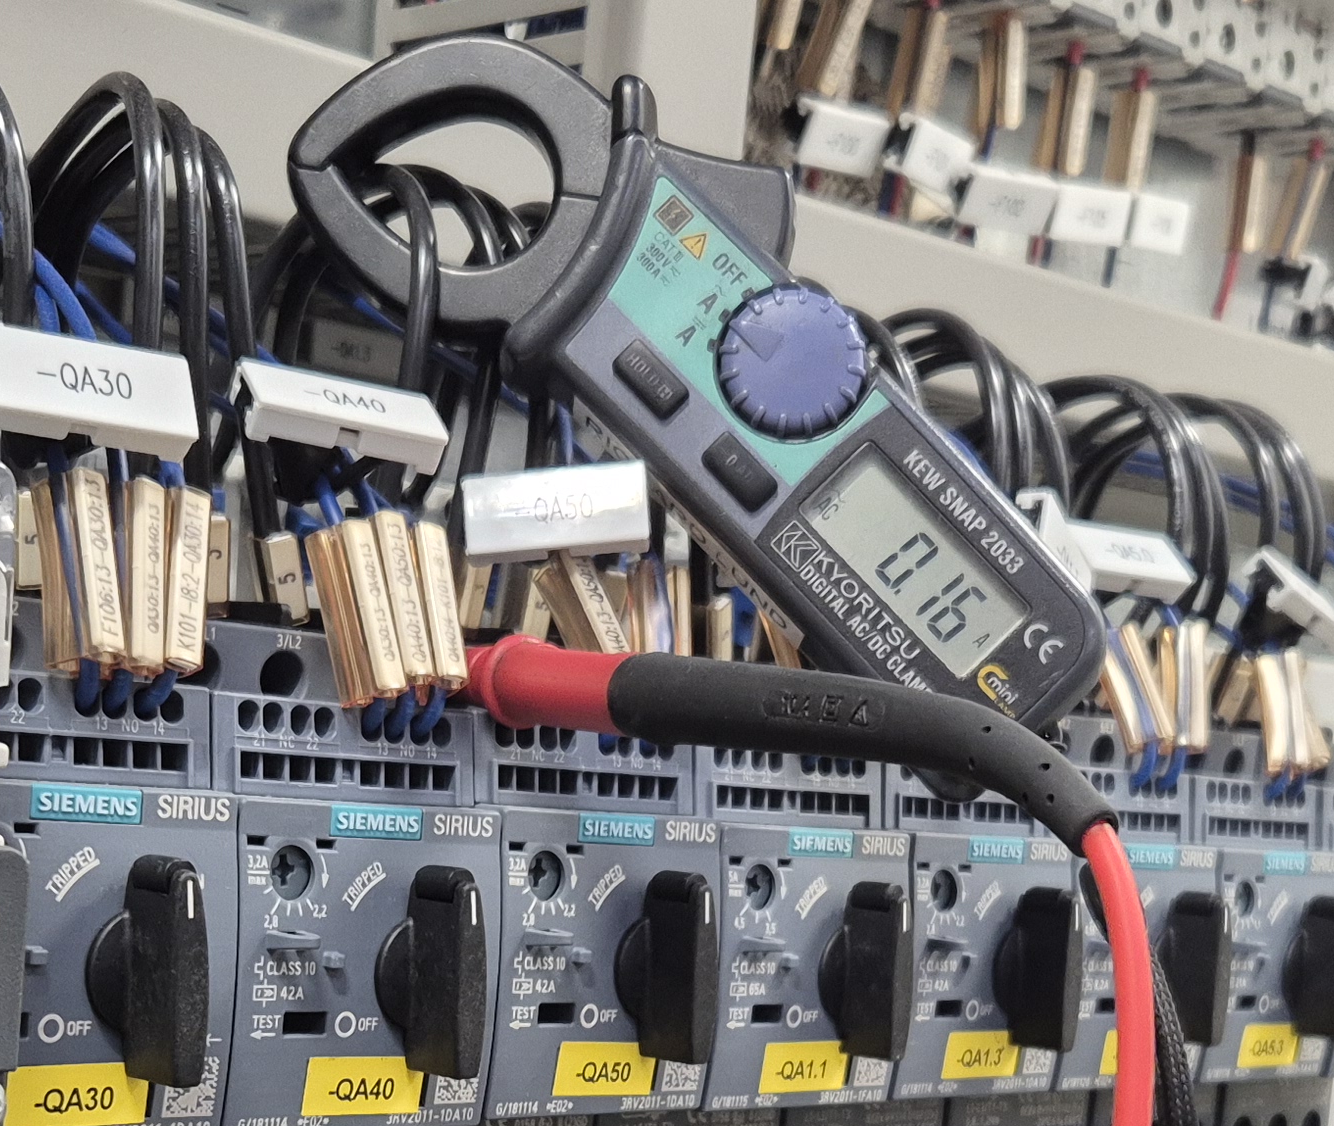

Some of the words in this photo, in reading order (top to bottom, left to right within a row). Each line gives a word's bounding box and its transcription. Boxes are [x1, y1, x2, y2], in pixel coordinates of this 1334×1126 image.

[712, 251, 749, 287] OFF
[695, 292, 719, 315] A
[674, 324, 698, 348] A
[37, 362, 134, 401] -QA30
[303, 388, 388, 415] -QA40
[815, 494, 840, 522] AC
[902, 449, 947, 492] KEW
[939, 487, 988, 533] SNAP
[980, 530, 1025, 575] 2033
[874, 531, 988, 644] 0.16
[799, 564, 852, 624] DIGITAL
[845, 613, 888, 662] AC/DC
[812, 549, 923, 662] KYORITSU
[276, 633, 304, 651] 3/L2
[972, 632, 991, 649] A
[1023, 622, 1065, 665] CE
[987, 672, 1020, 706] mini
[94, 715, 109, 730] 13
[120, 719, 140, 734] NO
[151, 720, 166, 736] 14
[36, 791, 139, 818] SIEMENS
[156, 793, 232, 823] SIRIUS
[336, 811, 421, 834] SIEMENS
[432, 812, 494, 838] SIRIUS
[583, 819, 654, 840] SIEMENS
[665, 820, 717, 844] SIRIUS
[792, 835, 853, 853] SIEMENS
[862, 836, 906, 857] SIRIUS
[971, 842, 1024, 859] SIEMENS
[1029, 841, 1068, 862] SIRIUS
[1179, 848, 1215, 867] SIRIUS
[44, 845, 99, 897] TRIPPED
[247, 855, 269, 871] 3,2A
[342, 859, 385, 906] TRIPPED
[587, 864, 623, 907] TRIPPED
[267, 960, 302, 978] CLASS
[304, 959, 316, 976] 10
[524, 956, 554, 971] CLASS
[739, 961, 766, 975] CLASS
[280, 985, 305, 1001] 42A
[535, 979, 556, 994] 42A
[251, 1014, 282, 1030] TEST
[357, 1015, 380, 1033] OFF
[511, 1006, 536, 1021] TEST
[599, 1008, 618, 1023] OFF
[65, 1019, 93, 1037] OFF
[575, 1061, 632, 1085] -QA50
[775, 1058, 828, 1081] -QA1.1
[32, 1084, 115, 1115] -QA30
[327, 1076, 396, 1102] -QA40
[385, 1106, 475, 1126] 3RV2011-1DA10
